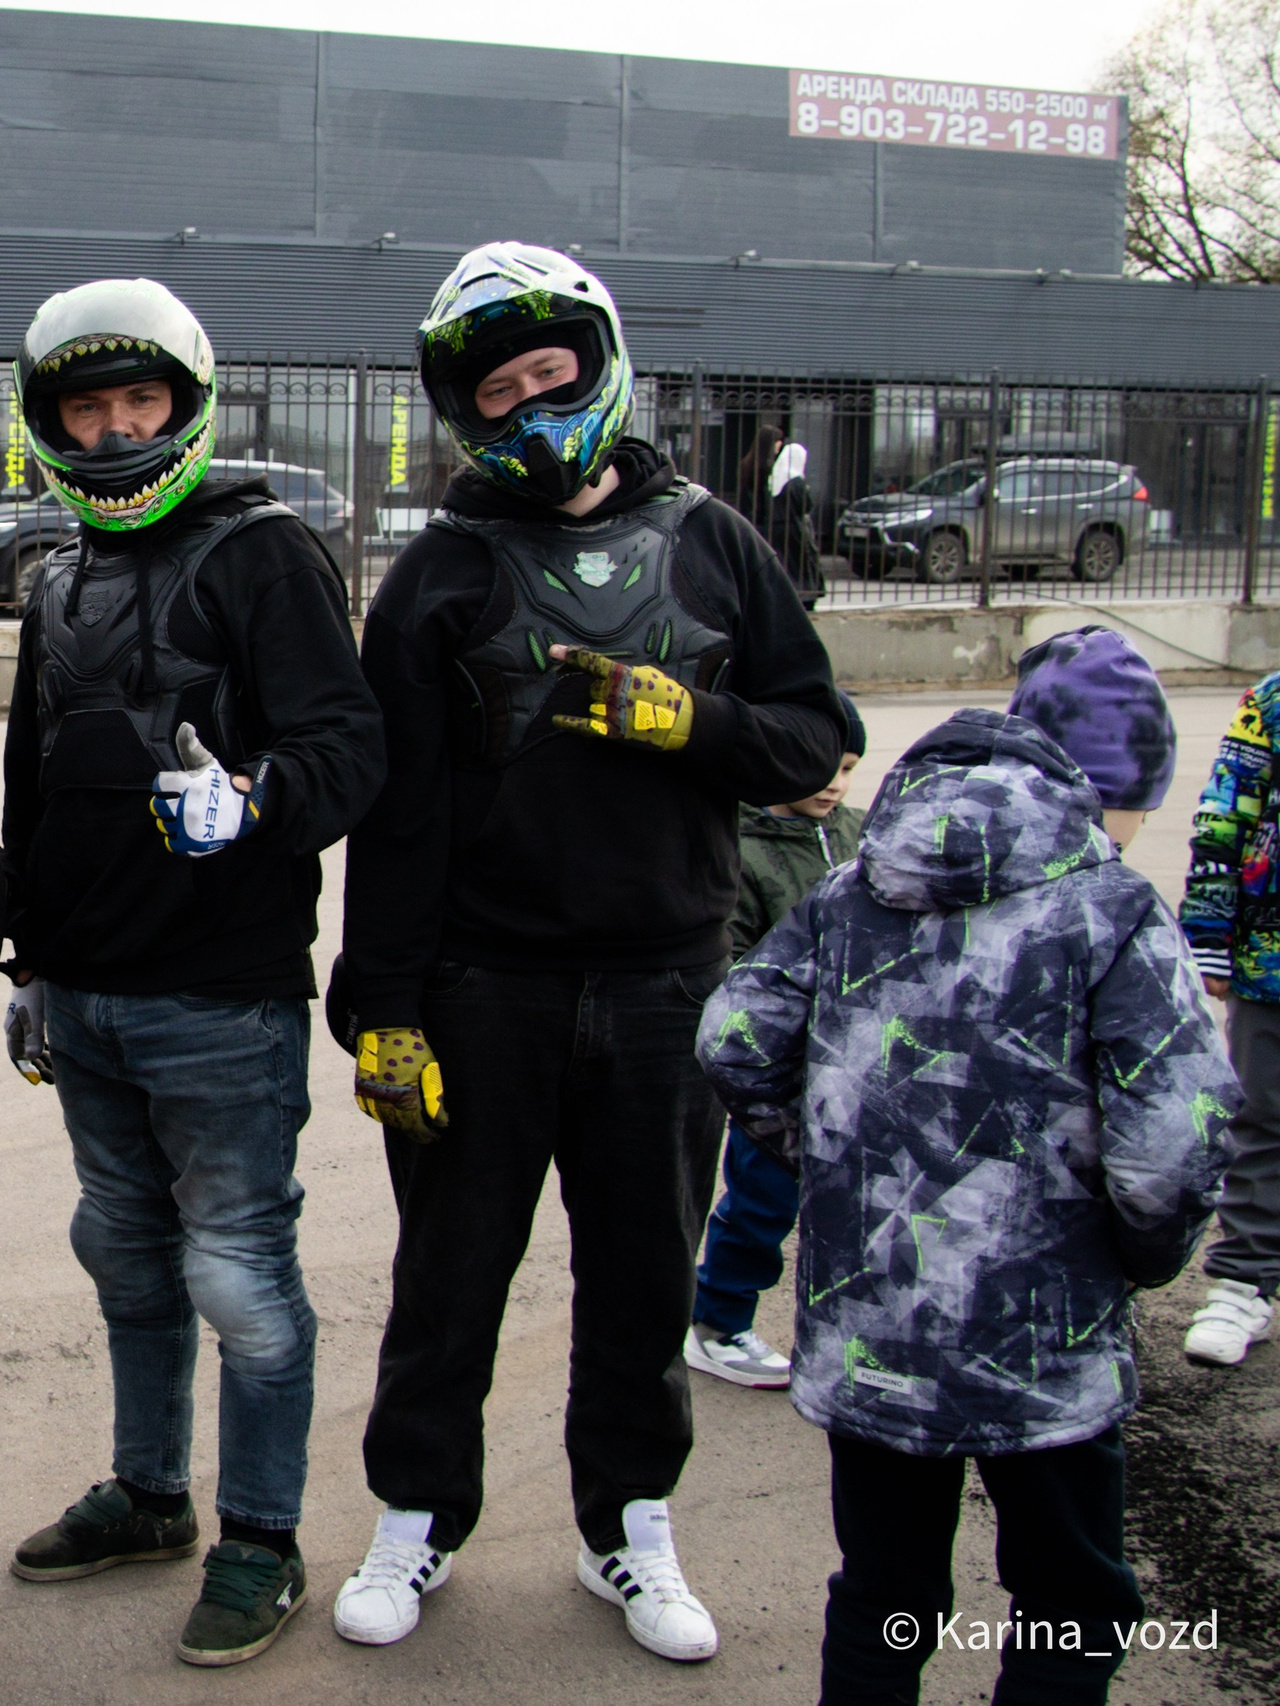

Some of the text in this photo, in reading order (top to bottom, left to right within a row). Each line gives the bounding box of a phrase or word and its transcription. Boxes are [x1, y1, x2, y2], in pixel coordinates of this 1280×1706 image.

[796, 73, 887, 106] АРЕНДА
[891, 80, 980, 114] СКЛАДА
[985, 88, 1088, 119] 550-2500
[797, 101, 1107, 156] 8-903-722-12-98
[390, 395, 408, 485] АРЕНДА
[256, 761, 270, 784] HIZER
[202, 768, 220, 840] HIZER
[861, 1371, 904, 1388] FUTURINO
